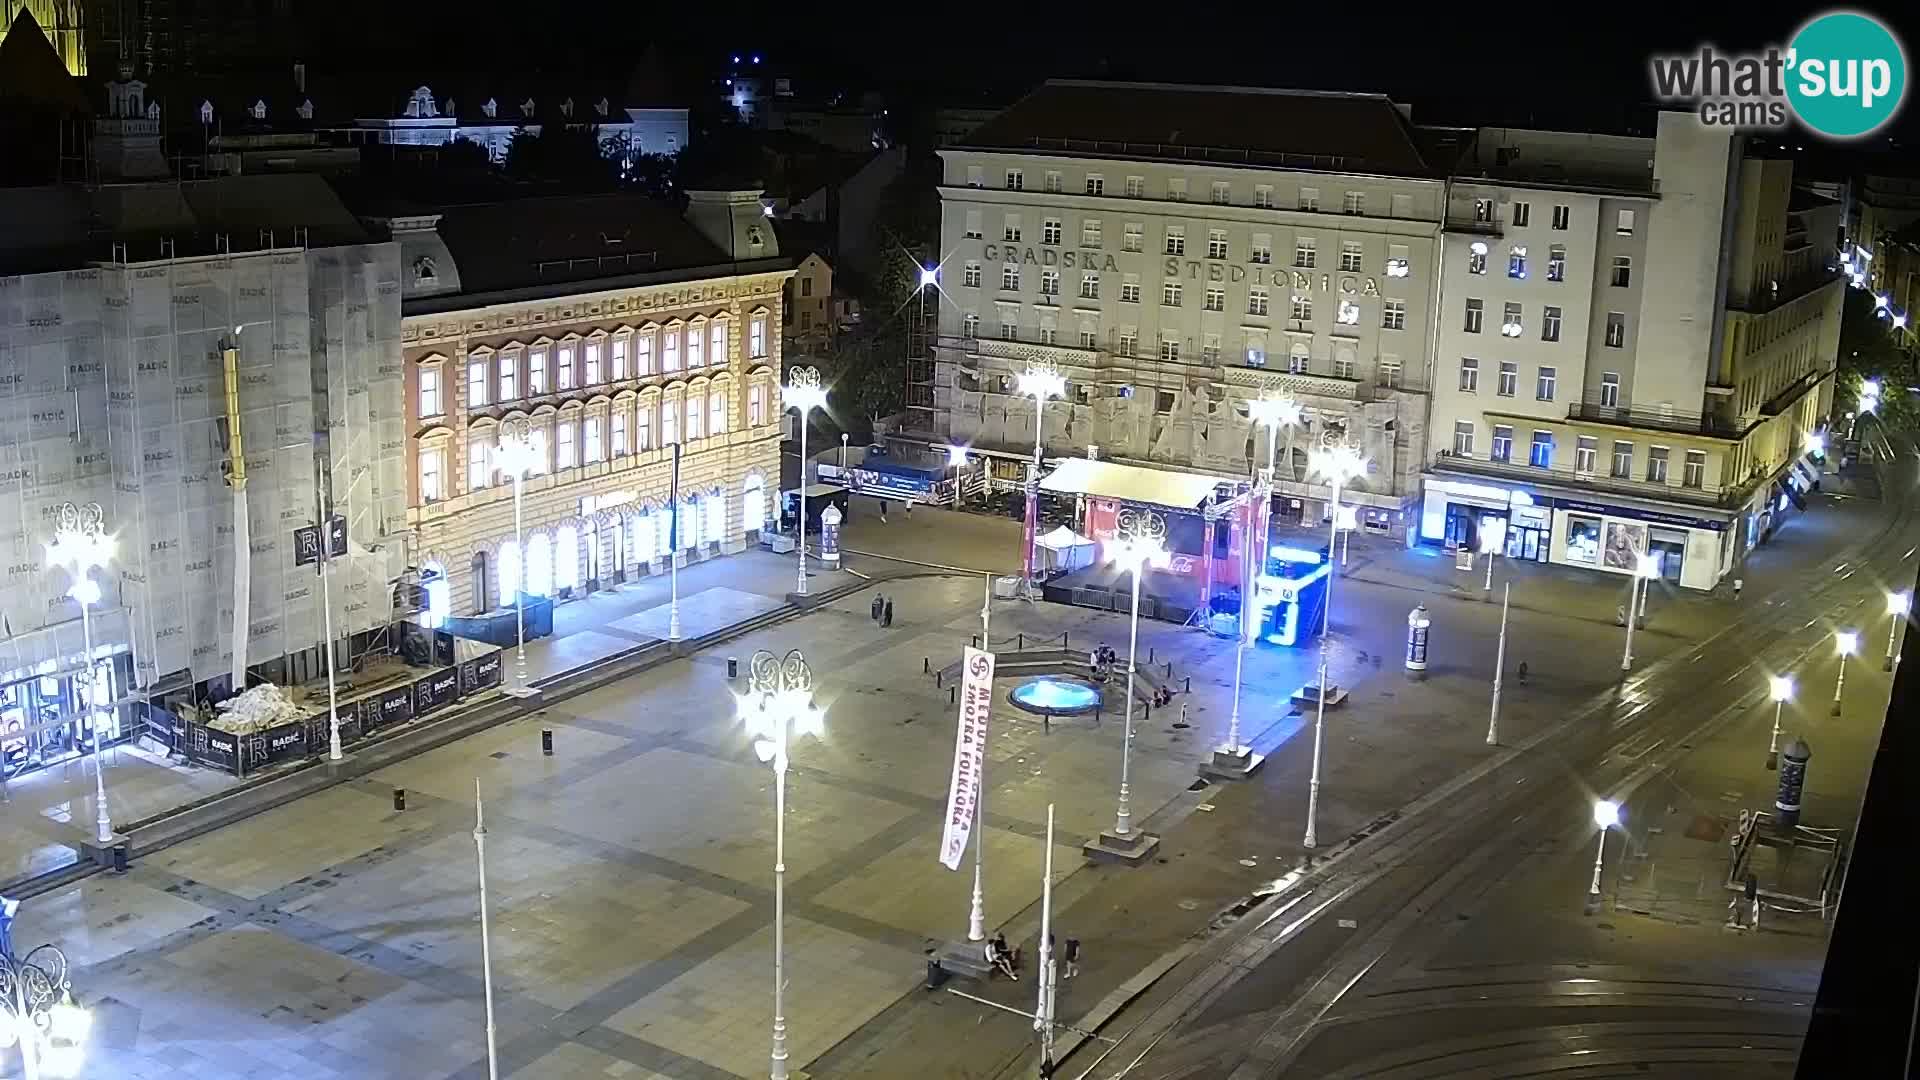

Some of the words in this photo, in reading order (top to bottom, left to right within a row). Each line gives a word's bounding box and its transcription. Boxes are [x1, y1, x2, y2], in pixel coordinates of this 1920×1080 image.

[984, 244, 1119, 272] GRADSKA
[963, 683, 977, 745] SMOTRA
[952, 751, 971, 826] FOLKLORA
